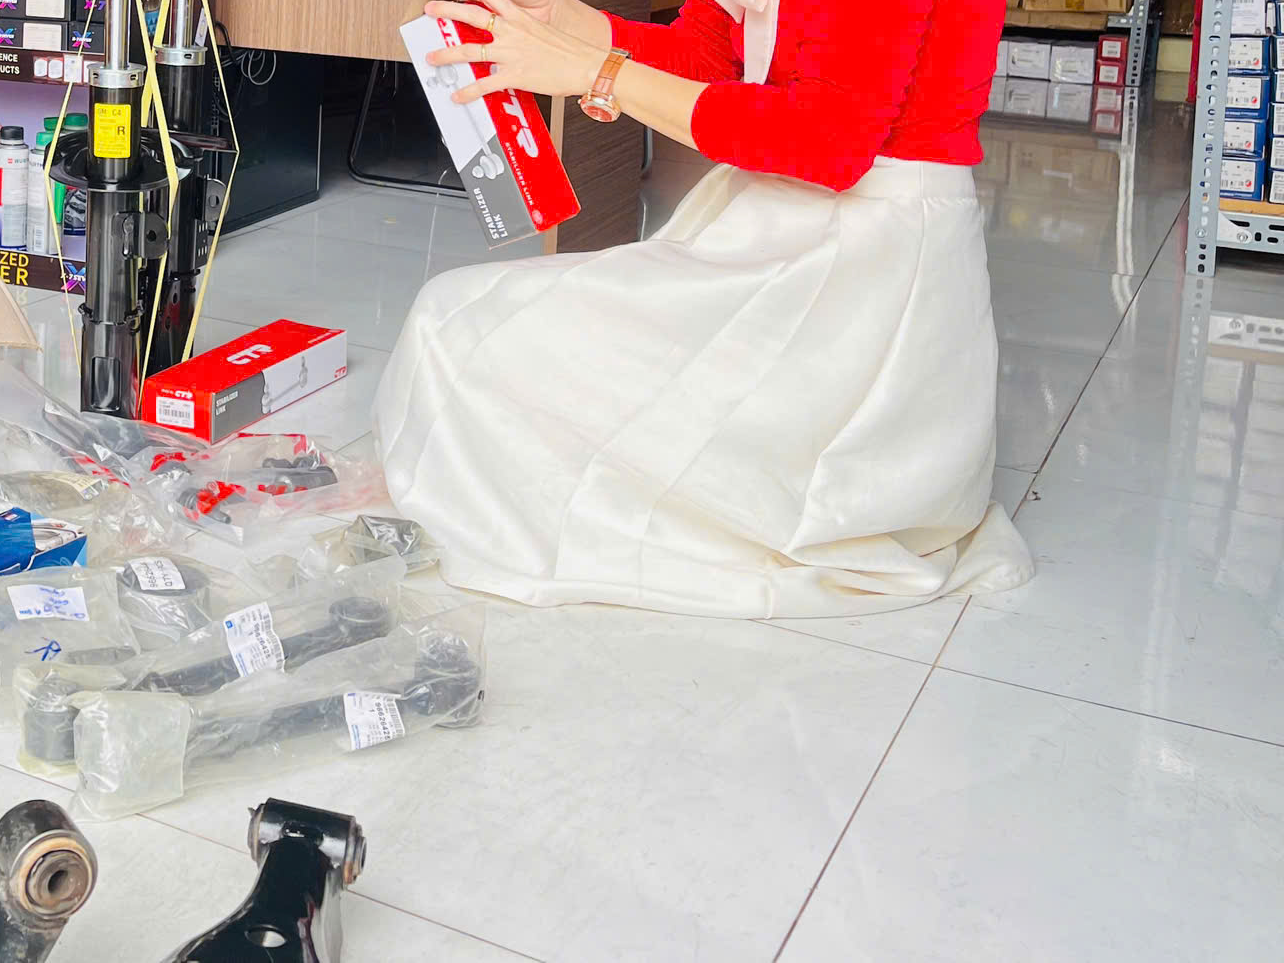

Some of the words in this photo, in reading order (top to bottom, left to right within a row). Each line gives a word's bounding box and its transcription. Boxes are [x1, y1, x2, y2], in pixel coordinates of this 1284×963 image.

[117, 126, 125, 136] R
[505, 142, 526, 188] STABILIZER
[522, 187, 534, 206] LINK
[473, 187, 498, 240] STABILIZER
[494, 214, 508, 238] LINK
[226, 343, 273, 365] CTR
